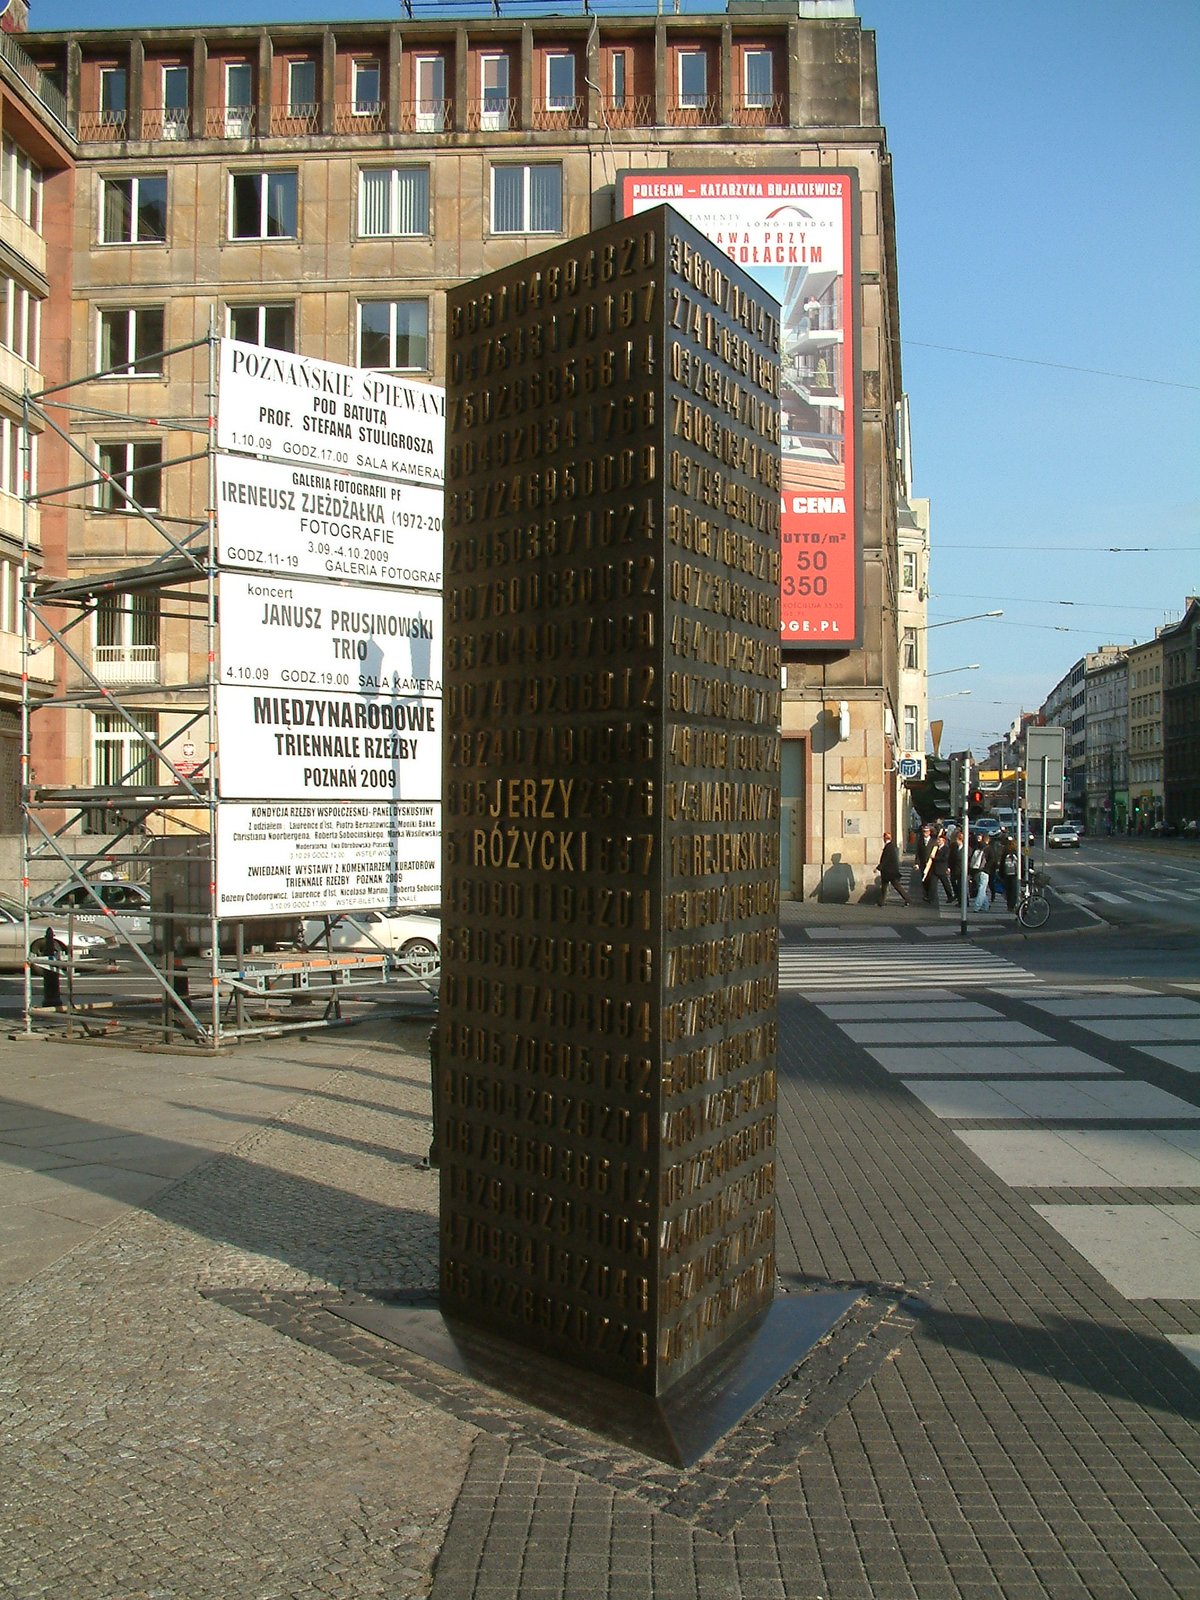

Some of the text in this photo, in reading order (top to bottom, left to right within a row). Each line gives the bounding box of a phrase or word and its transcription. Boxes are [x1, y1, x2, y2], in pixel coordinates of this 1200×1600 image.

[633, 184, 683, 197] POLECAM
[700, 183, 763, 197] KATARZYNA
[767, 183, 842, 196] BUJAKIEWICZ
[764, 232, 806, 244] PRZY
[232, 349, 354, 398] POZNAŃSKIE
[313, 396, 336, 416] POD
[259, 406, 434, 455] PROF. STEFANA STULIGROSZA
[231, 432, 272, 450] 1.10.09
[356, 454, 388, 471] SALA
[292, 472, 331, 491] GALERIA
[222, 481, 296, 511] IRENEUSZ
[301, 492, 385, 524] ZJEŻDŻAŁKA
[792, 498, 847, 514] CENA
[300, 518, 395, 545] FOTOGRAFIE
[325, 559, 442, 584] GALERIA FOTOGRAF
[797, 551, 827, 571] 50
[248, 582, 293, 599] koncert
[262, 603, 433, 640] JANUSZ PRUSINOWSKI
[332, 638, 368, 661] TRIO
[227, 666, 269, 680] 4.10.09
[358, 674, 390, 688] SALA
[253, 696, 436, 732] MIĘDZYNARODOWE
[274, 732, 360, 758] TRIENNALE
[304, 765, 397, 788] POZNAŃ 2009
[489, 775, 574, 817] JERZY
[701, 779, 757, 821] MARIAN
[473, 821, 588, 872] RÓŻYCKI
[693, 831, 763, 875] REJEWSKI
[248, 866, 291, 877] ZWIEDZANIE
[295, 864, 333, 875] WYSTAWY
[286, 876, 323, 887] TRIENNALE
